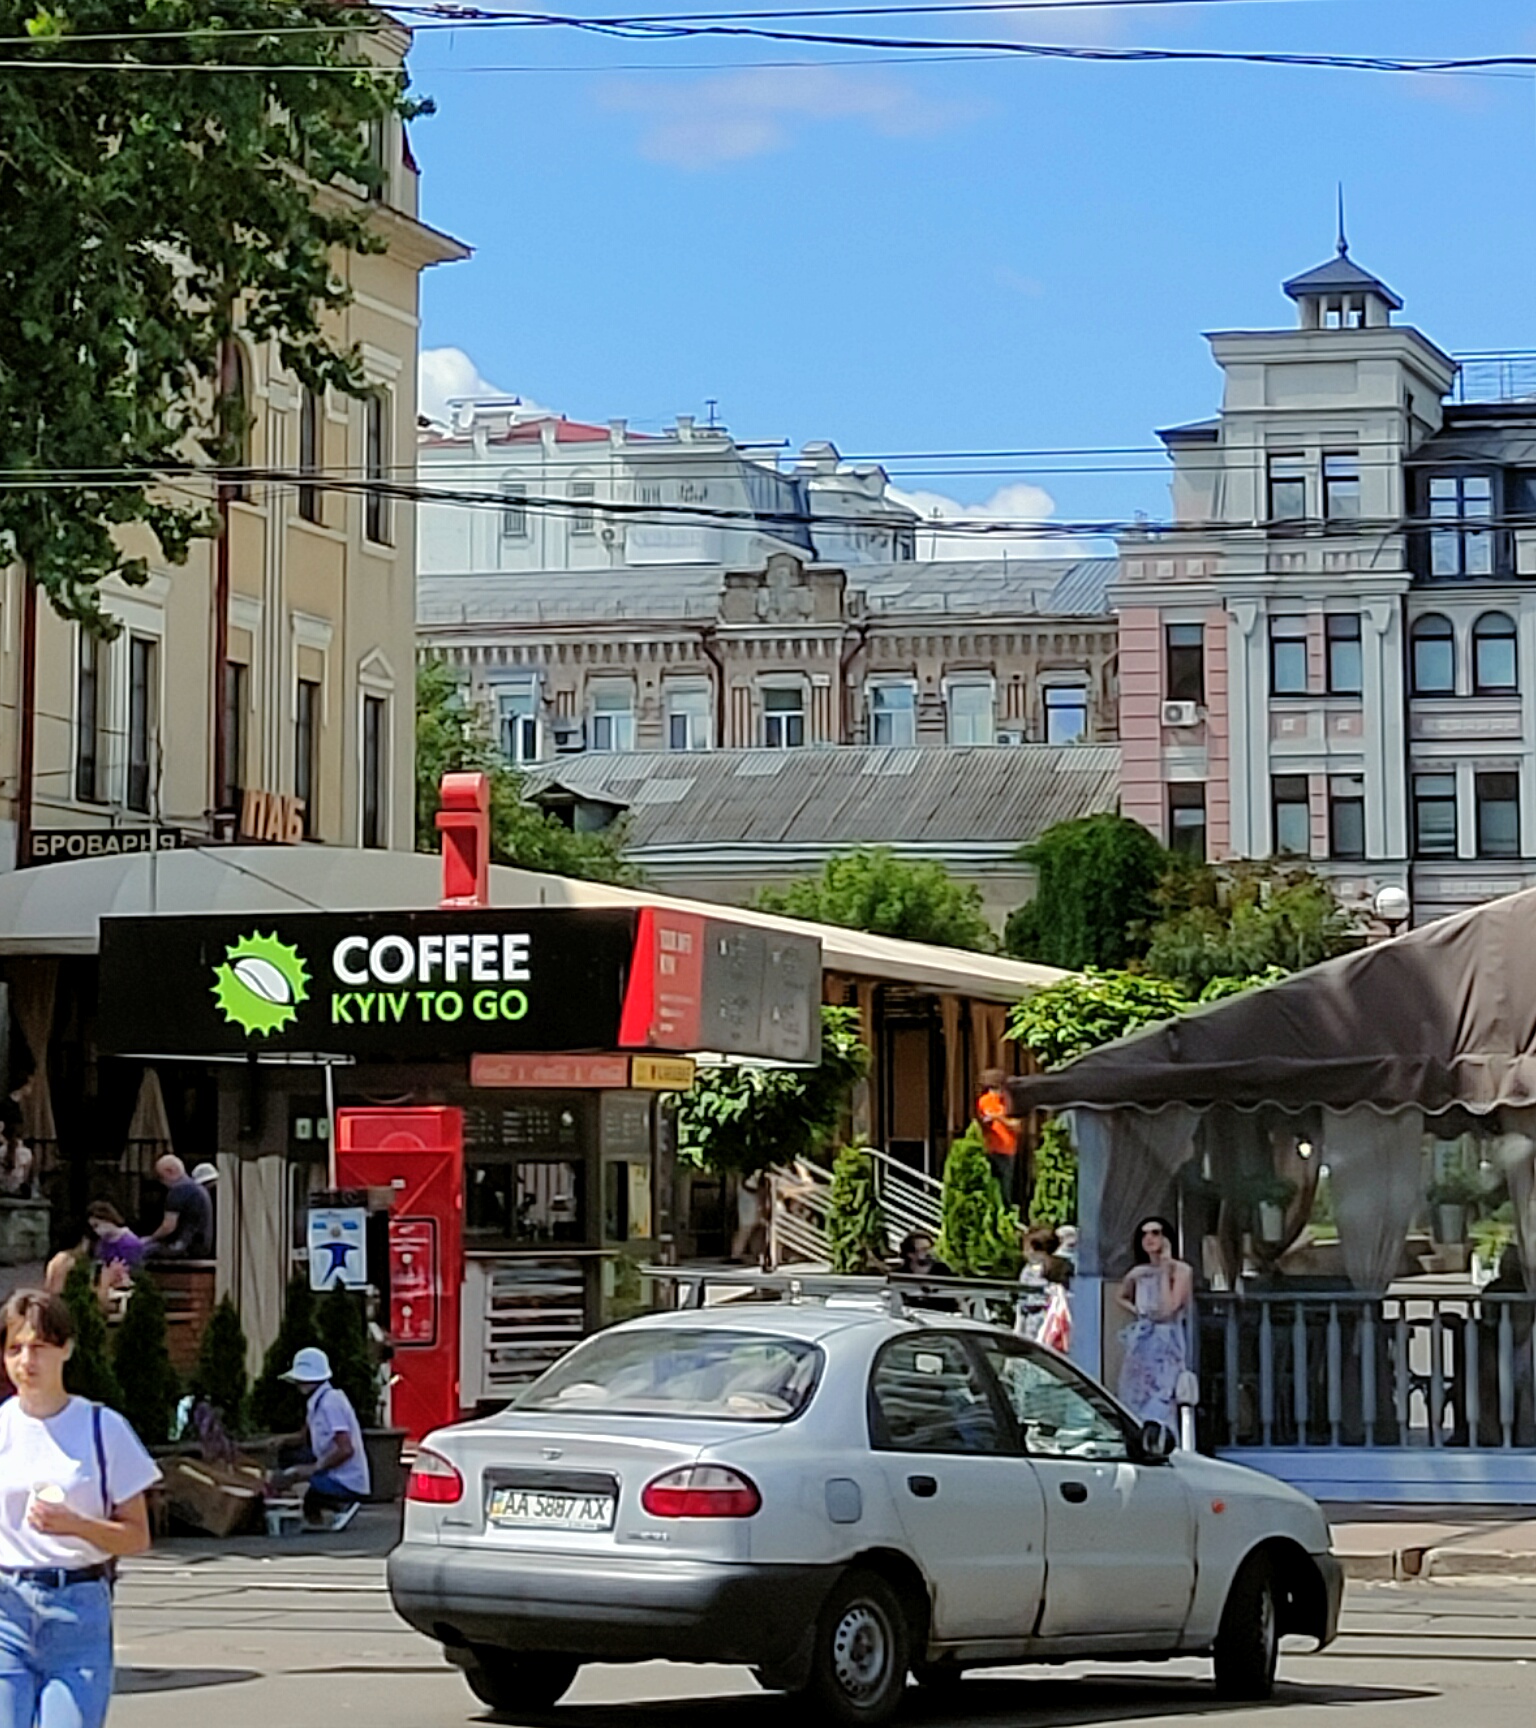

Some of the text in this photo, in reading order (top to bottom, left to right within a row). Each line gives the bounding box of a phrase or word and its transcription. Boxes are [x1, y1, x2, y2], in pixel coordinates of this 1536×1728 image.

[241, 788, 306, 844] ПАБ
[31, 834, 177, 857] БРОВАРНЯ
[332, 933, 531, 985] COFFEE
[331, 989, 529, 1024] KYIV TO GO
[504, 1492, 529, 1516] AA
[579, 1498, 606, 1520] AX
